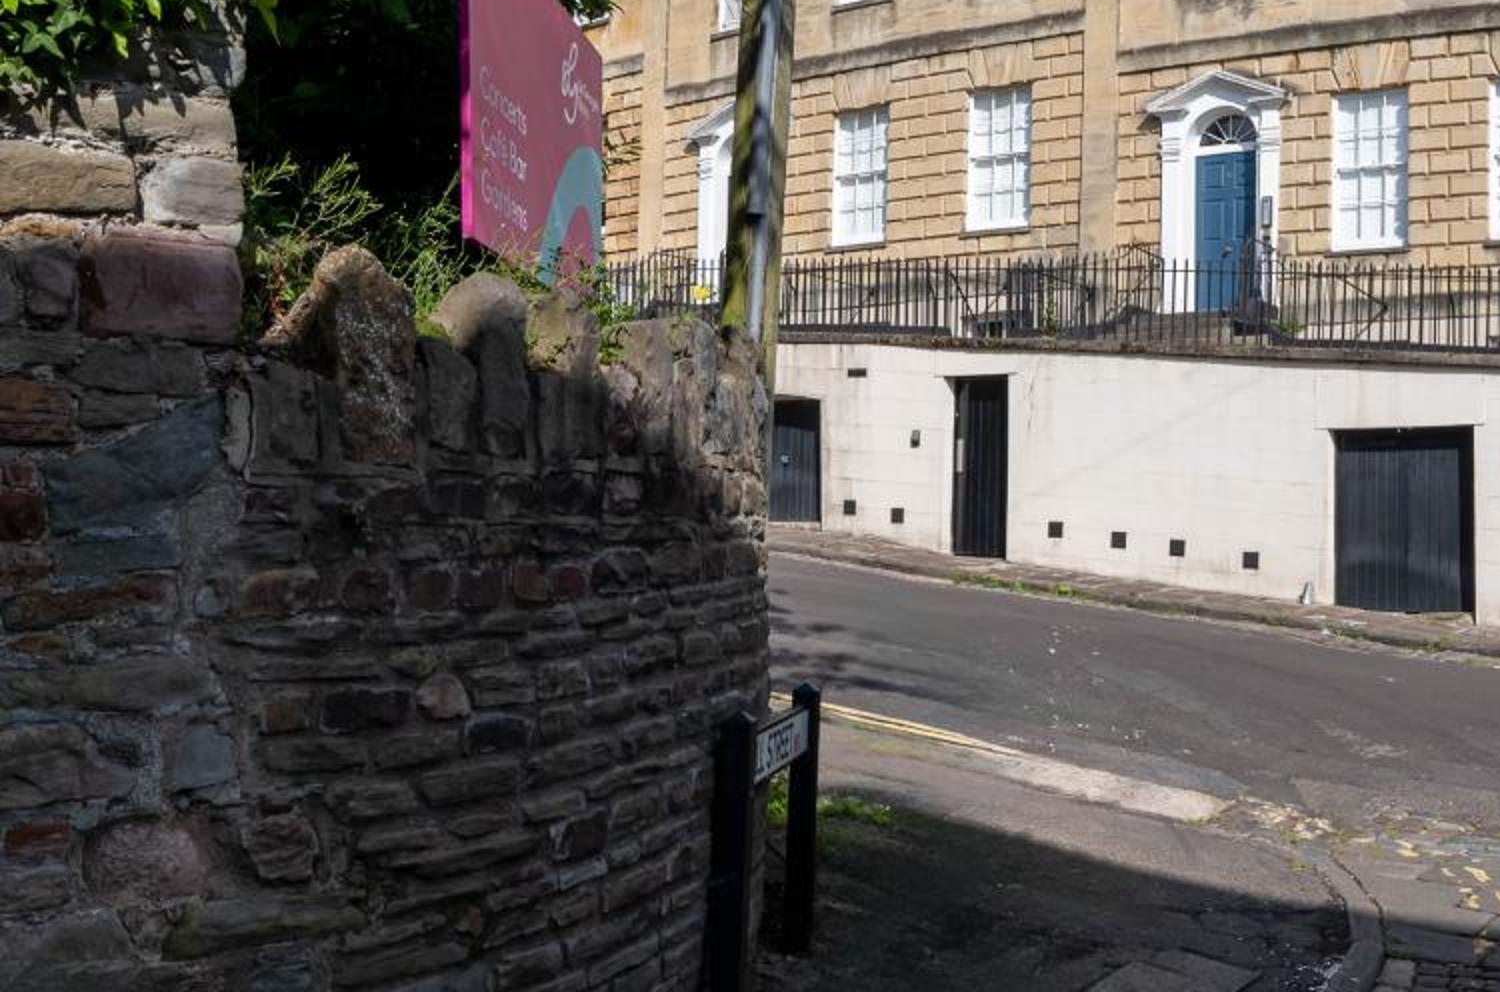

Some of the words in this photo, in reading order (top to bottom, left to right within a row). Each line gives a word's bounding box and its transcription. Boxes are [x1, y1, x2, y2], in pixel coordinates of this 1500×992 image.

[480, 65, 527, 136] Concerts
[510, 140, 527, 181] Bar
[481, 167, 528, 233] Gardens
[767, 722, 794, 769] STREET
